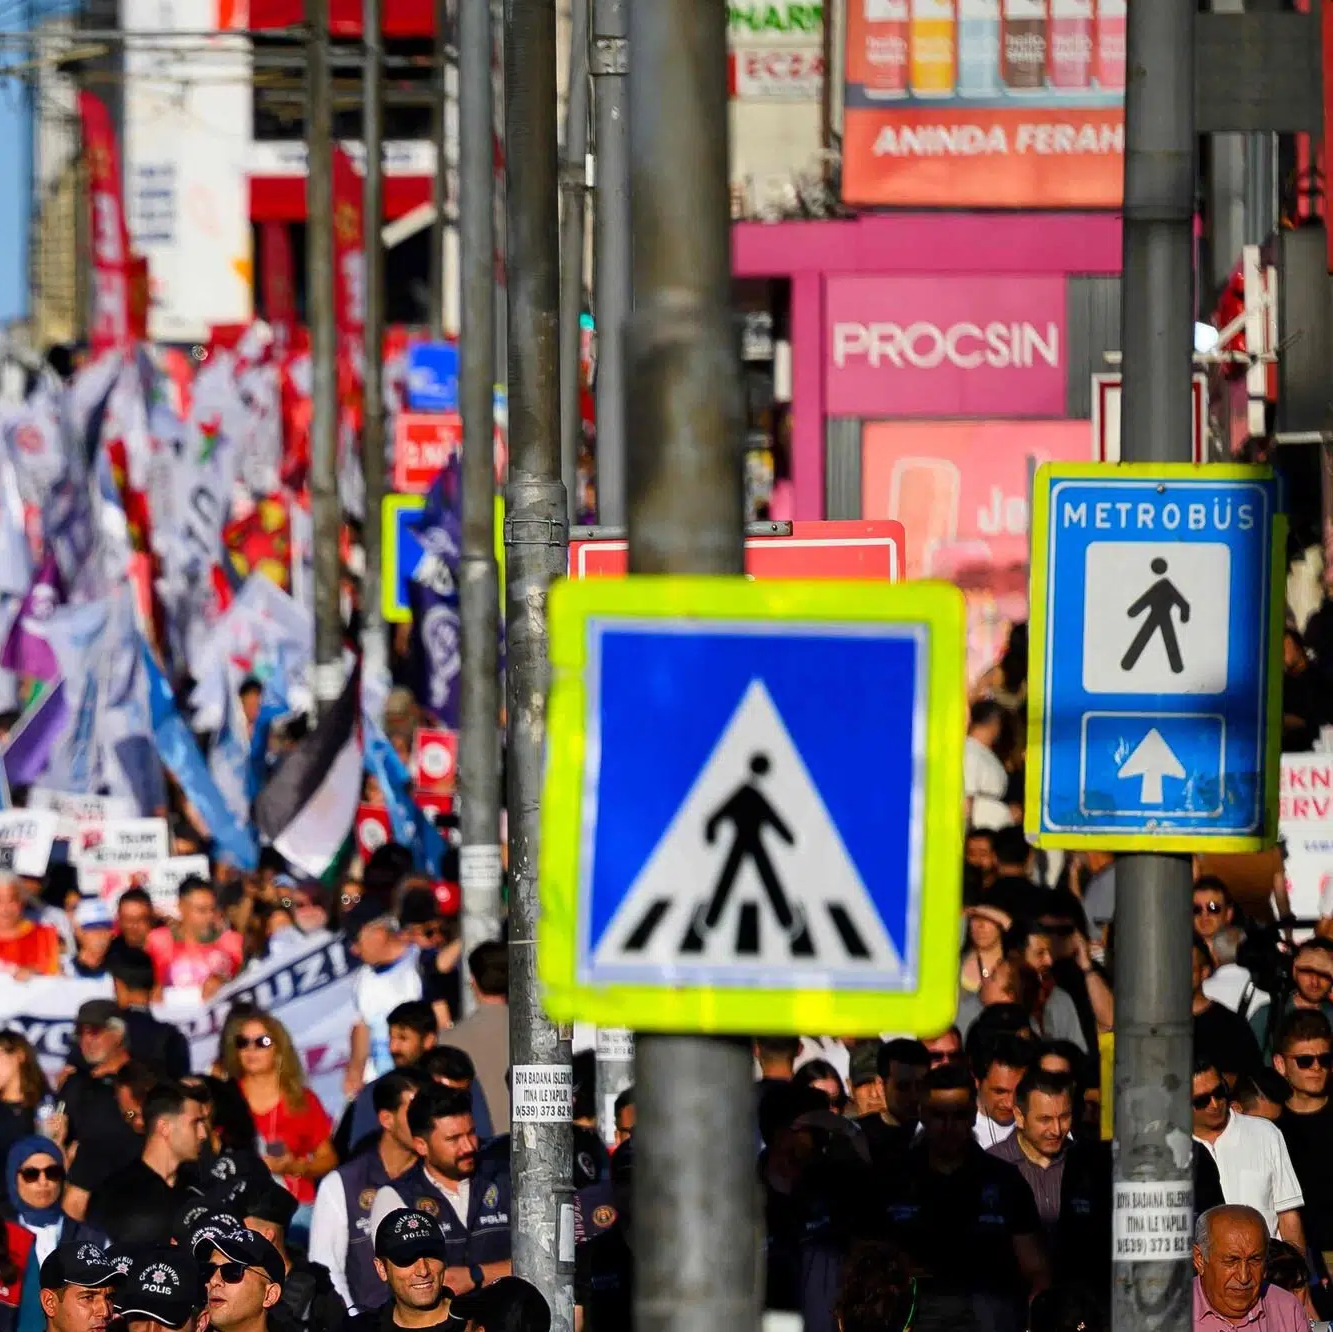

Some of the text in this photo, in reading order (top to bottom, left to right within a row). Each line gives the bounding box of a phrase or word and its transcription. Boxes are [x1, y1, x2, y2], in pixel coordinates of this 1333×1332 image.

[873, 124, 1009, 157] ANINDA
[834, 321, 1059, 368] PROCSIN
[1063, 498, 1254, 530] METROBÜS
[540, 1105, 555, 1116] 373
[401, 1229, 430, 1241] POLİS
